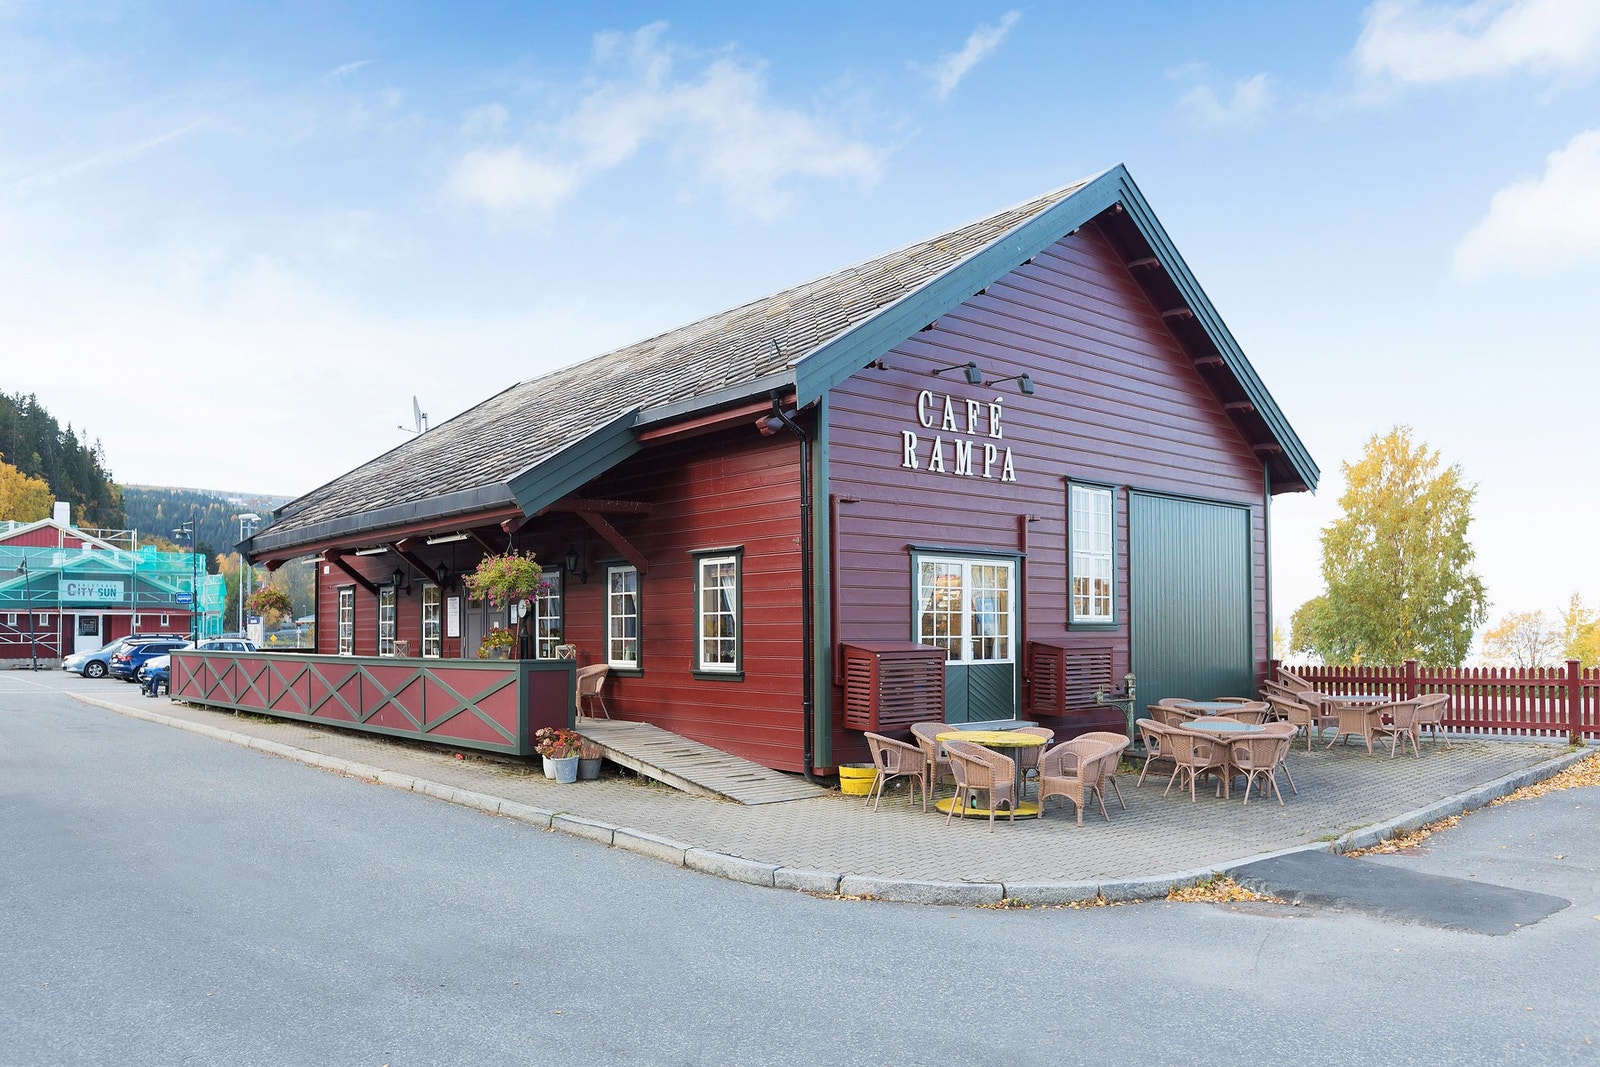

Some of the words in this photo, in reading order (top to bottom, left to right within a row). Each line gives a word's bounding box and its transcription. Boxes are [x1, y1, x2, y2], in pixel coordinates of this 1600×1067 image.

[918, 390, 1004, 439] CAFÉ
[901, 430, 1017, 482] RAMPA
[67, 583, 94, 597] CITY
[97, 587, 117, 597] SUN
